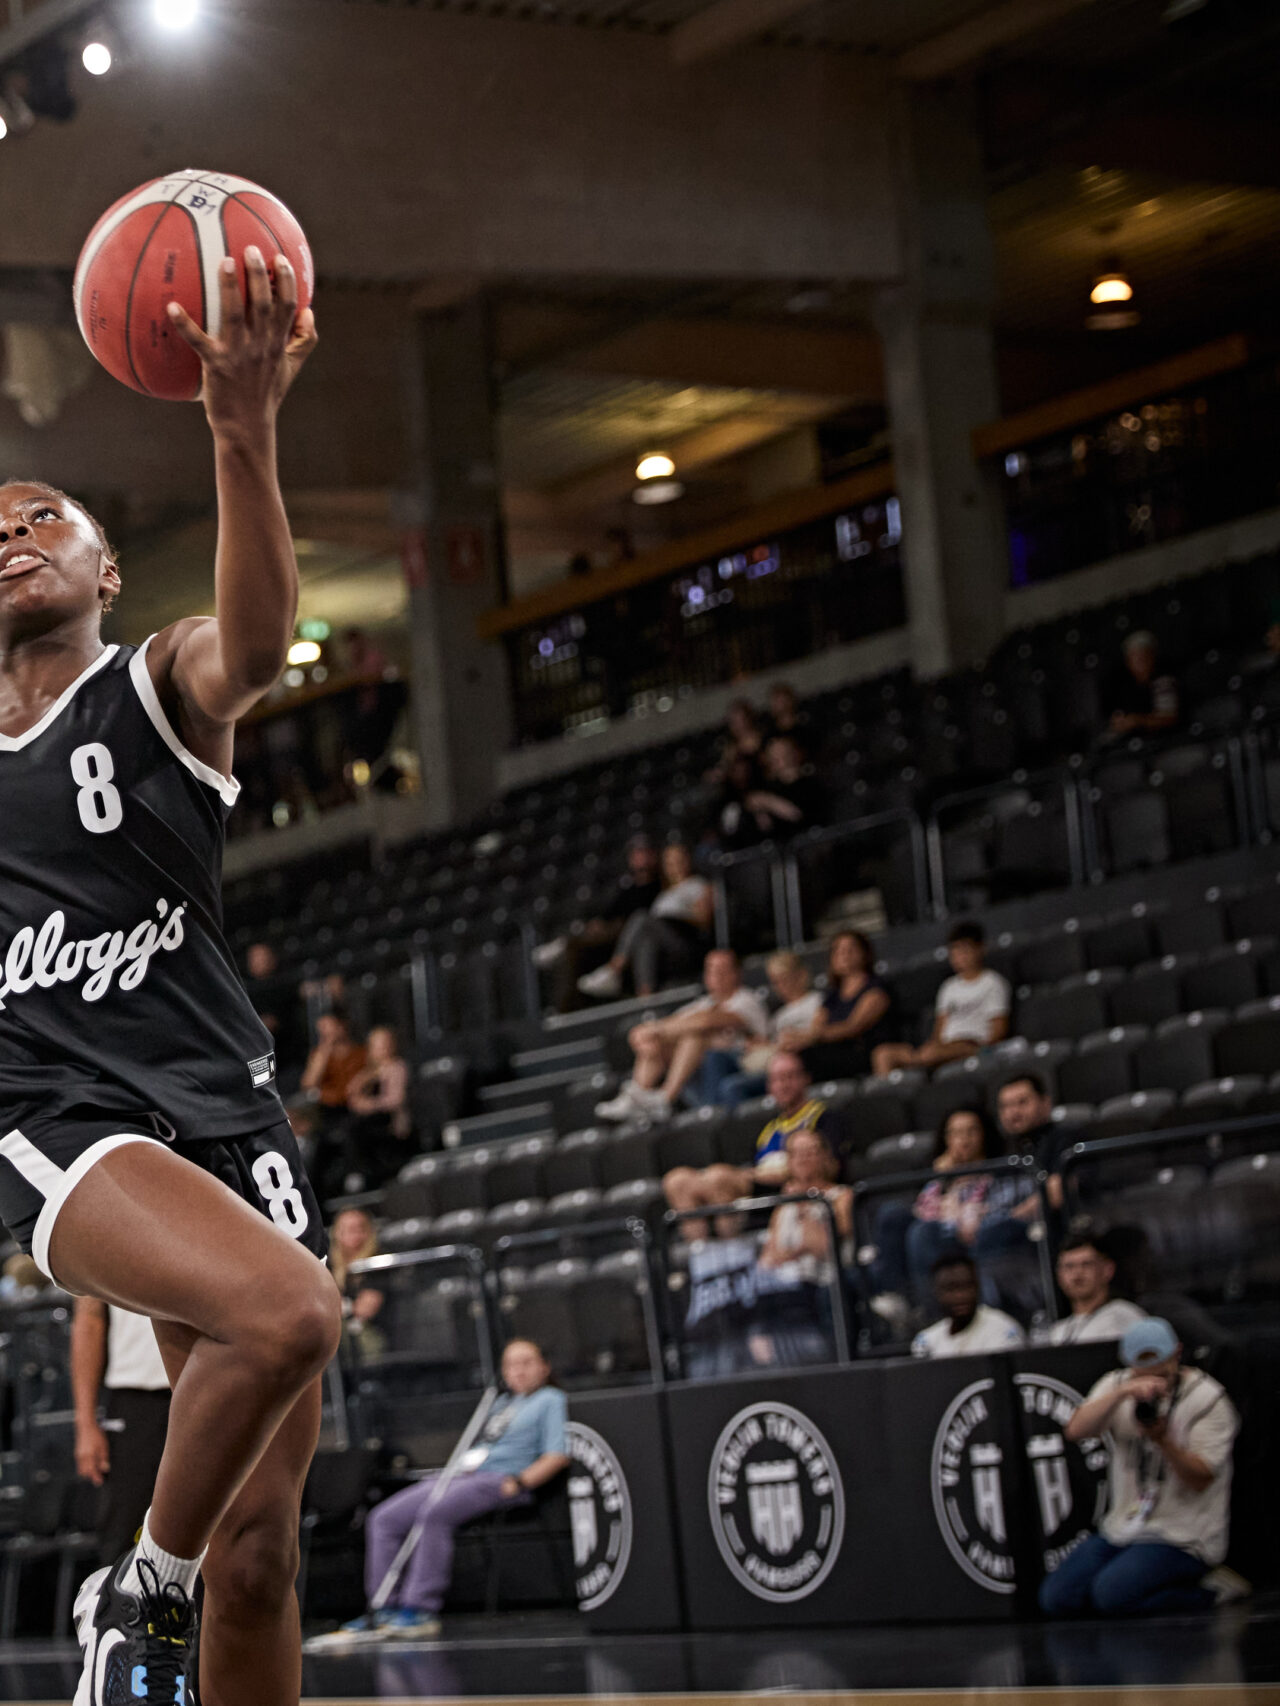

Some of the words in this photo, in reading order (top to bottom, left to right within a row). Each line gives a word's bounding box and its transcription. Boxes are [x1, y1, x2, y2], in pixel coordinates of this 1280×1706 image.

[70, 742, 123, 834] 8
[251, 1150, 309, 1239] 8
[764, 1412, 835, 1497] TOWERS
